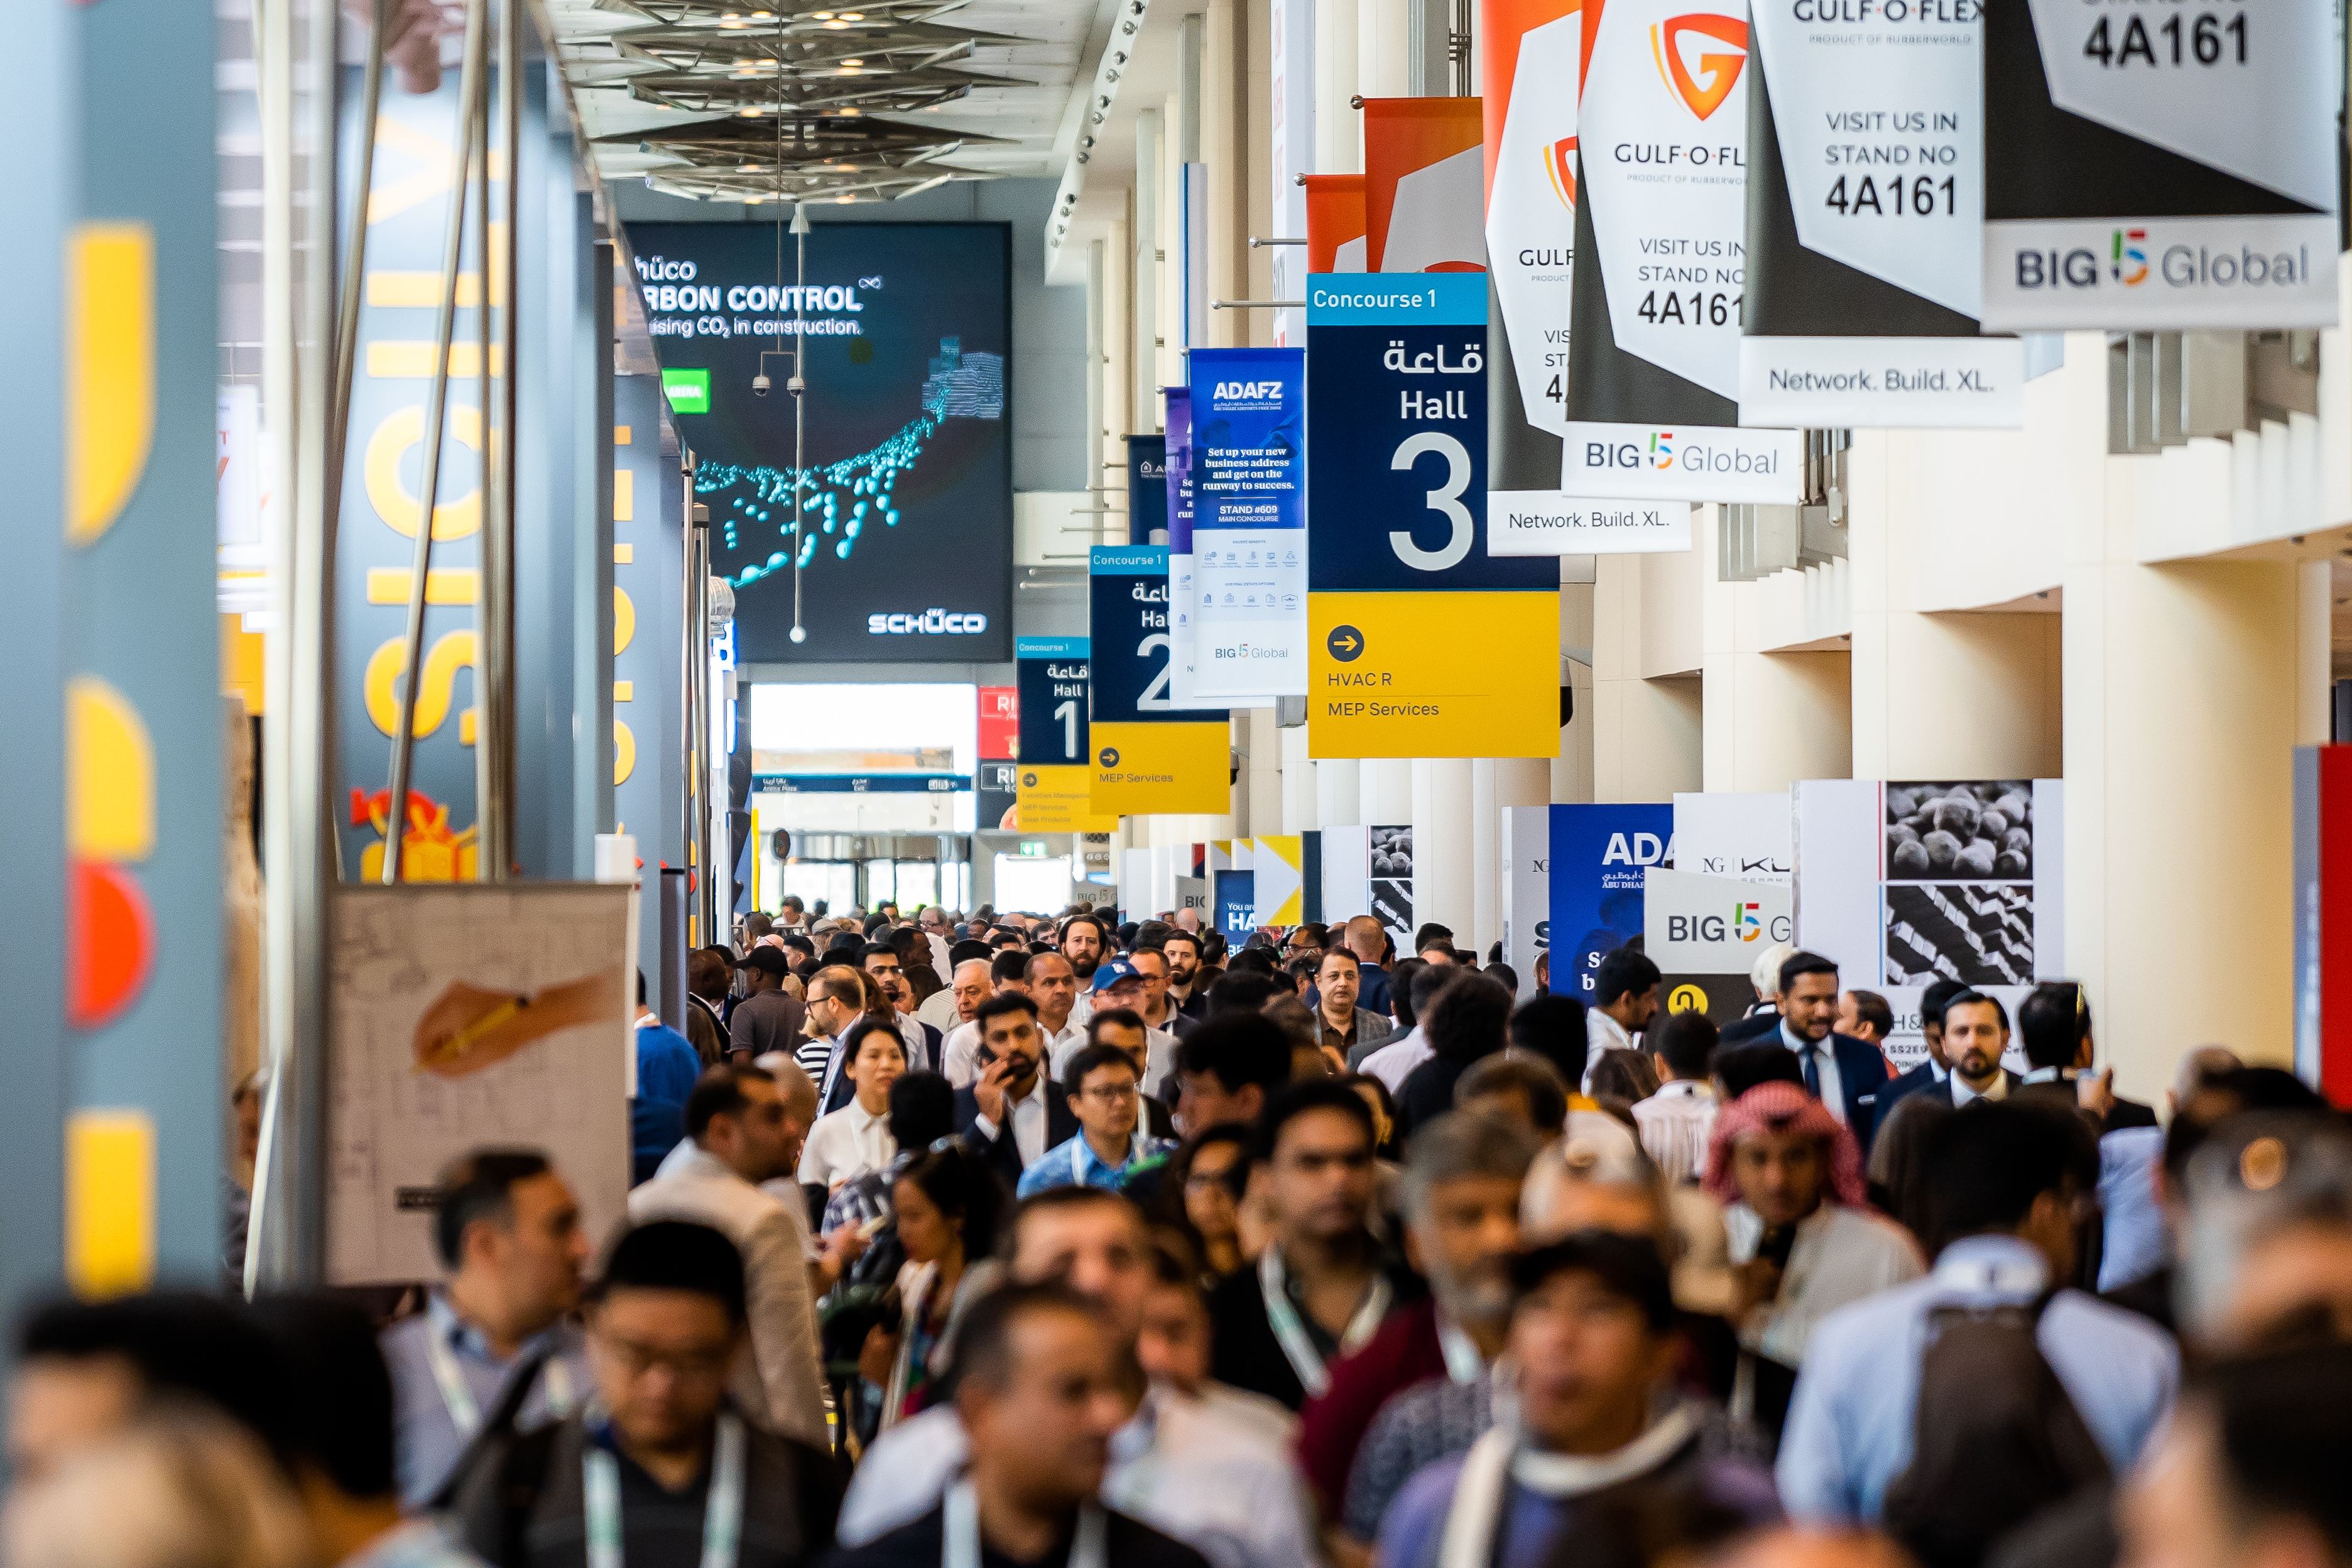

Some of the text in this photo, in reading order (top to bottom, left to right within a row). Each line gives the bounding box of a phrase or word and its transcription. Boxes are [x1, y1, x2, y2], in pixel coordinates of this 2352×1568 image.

[2083, 11, 2249, 67] 4A161
[1826, 112, 1958, 132] VISIT US IN
[1825, 145, 1957, 165] STAND NO
[1627, 173, 1671, 183] PRODUCT
[1674, 174, 1687, 183] OF
[1825, 175, 1956, 216] 4A161
[1640, 238, 1689, 255] VISIT
[1695, 240, 1721, 256] US
[1638, 266, 1744, 285] STAND NO
[2015, 248, 2098, 289] BIG
[2162, 244, 2309, 288] Global
[727, 285, 864, 312] CONTROL
[1313, 289, 1436, 308] Concourse 1
[1638, 291, 1743, 326] 4A161
[734, 316, 753, 335] in
[753, 317, 864, 336] construction.
[1383, 340, 1483, 374] قاعة
[1545, 353, 1571, 367] ST
[1768, 369, 1995, 392] Network. Build. XL.
[1212, 381, 1282, 400] ADAFZ
[1400, 390, 1468, 420] Hall
[1207, 448, 1224, 457] Set
[1225, 449, 1239, 458] up
[1241, 449, 1264, 458] your
[1585, 442, 1639, 469] BIG
[1682, 445, 1777, 474] Global
[1205, 458, 1290, 467] business address
[1212, 470, 1233, 479] and
[1234, 471, 1250, 480] get
[1265, 470, 1282, 478] the
[1202, 482, 1241, 491] runway
[1254, 481, 1295, 489] success.
[1219, 505, 1278, 514] STAND #609
[1388, 431, 1475, 572] 3
[1509, 511, 1670, 529] Network. Build. XL.
[1093, 555, 1162, 565] Concourse 1
[868, 607, 988, 636] SCHÜCO
[1019, 643, 1064, 651] Concourse
[1215, 648, 1236, 658] BIG
[1251, 648, 1288, 658] Global
[1047, 664, 1088, 679] قاعة
[1328, 672, 1393, 687] HVAC R
[1054, 683, 1082, 697] Hall
[1328, 702, 1439, 716] MEP Services
[1055, 700, 1076, 759] 1
[1099, 773, 1173, 783] MEP Services
[1077, 893, 1096, 902] BIG
[1227, 903, 1242, 911] You
[1669, 915, 1725, 942] BIG
